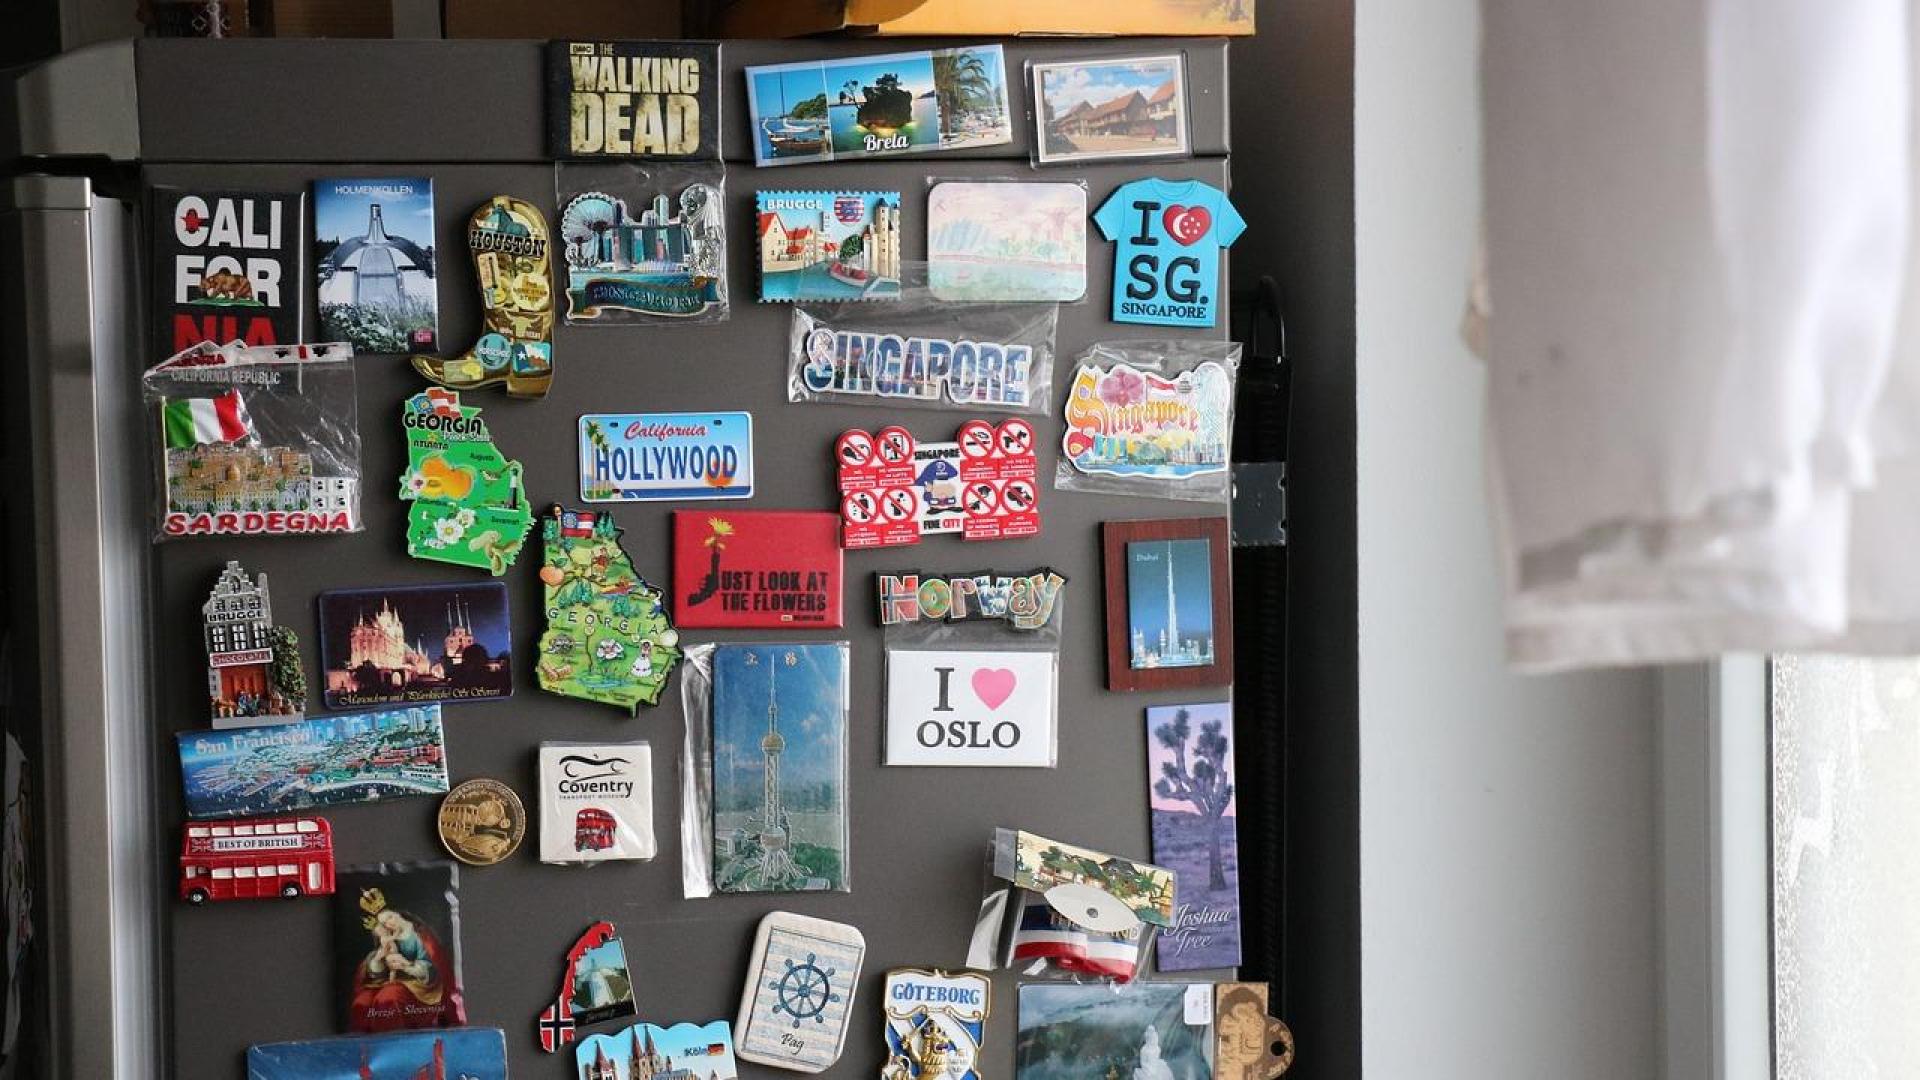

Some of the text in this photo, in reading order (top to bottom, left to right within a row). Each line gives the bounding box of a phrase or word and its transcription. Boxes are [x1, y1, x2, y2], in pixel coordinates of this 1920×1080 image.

[570, 56, 700, 93] WALKING
[571, 92, 700, 155] DEAD
[863, 134, 910, 151] Brela
[335, 185, 413, 195] HOLMENKOLLEN
[767, 199, 823, 209] BRUGGE
[175, 195, 282, 249] CALI
[1130, 200, 1161, 246] I
[469, 230, 546, 257] HOUSTON
[176, 255, 281, 306] FOR
[1126, 254, 1209, 304] SG.
[1121, 303, 1206, 318] SINGAPORE
[171, 370, 281, 385] CALIFORNIA REPUBLIC
[804, 329, 1032, 405] SINGAPORE
[1069, 372, 1200, 436] Singapore
[624, 420, 708, 441] California
[596, 445, 738, 481] HOLLYWOOD
[914, 448, 960, 460] SINGAPORE
[165, 512, 351, 534] SARDEGNA
[759, 571, 800, 591] LOOK
[807, 572, 828, 591] AT
[721, 592, 826, 611] THE FLOWERS
[880, 572, 1065, 629] Norway
[933, 667, 954, 711] I
[197, 732, 309, 754] San Francisco
[916, 720, 1021, 748] OSLO
[559, 779, 633, 798] Coventry
[218, 836, 298, 848] BEST OF BRITISH
[1165, 903, 1231, 937] Joshua
[1175, 930, 1212, 957] Tree
[892, 982, 981, 1005] GÖTEBORG
[781, 1033, 804, 1055] Pag
